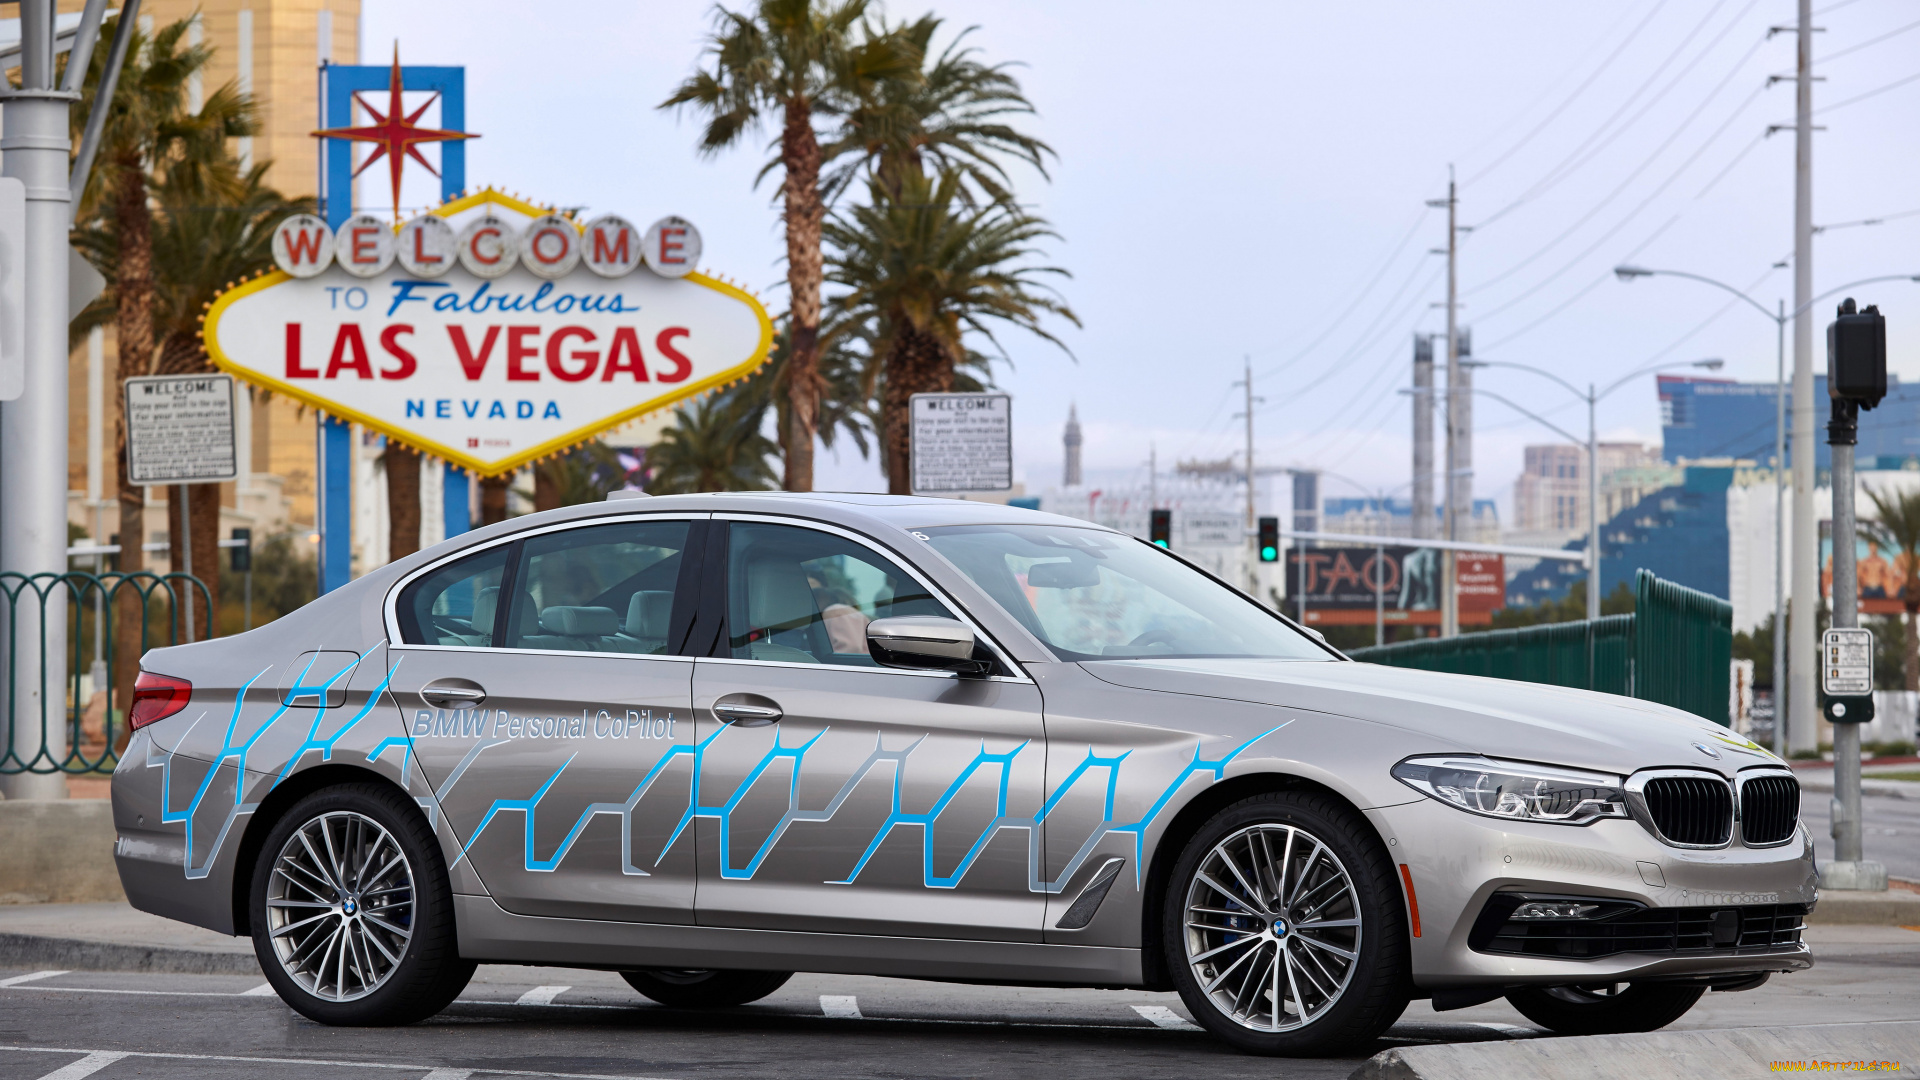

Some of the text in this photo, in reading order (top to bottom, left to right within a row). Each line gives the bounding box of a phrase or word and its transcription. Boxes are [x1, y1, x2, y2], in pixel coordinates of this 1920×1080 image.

[282, 227, 688, 265] WELCOME
[325, 280, 640, 317] TO Fabulous
[285, 322, 693, 384] LAS VEGAS
[143, 381, 216, 395] WELCOME
[928, 399, 996, 410] WELCOME
[406, 399, 562, 420] NEVADA
[1290, 551, 1400, 594] TAO
[411, 709, 677, 740] BMW Personal CoPilot
